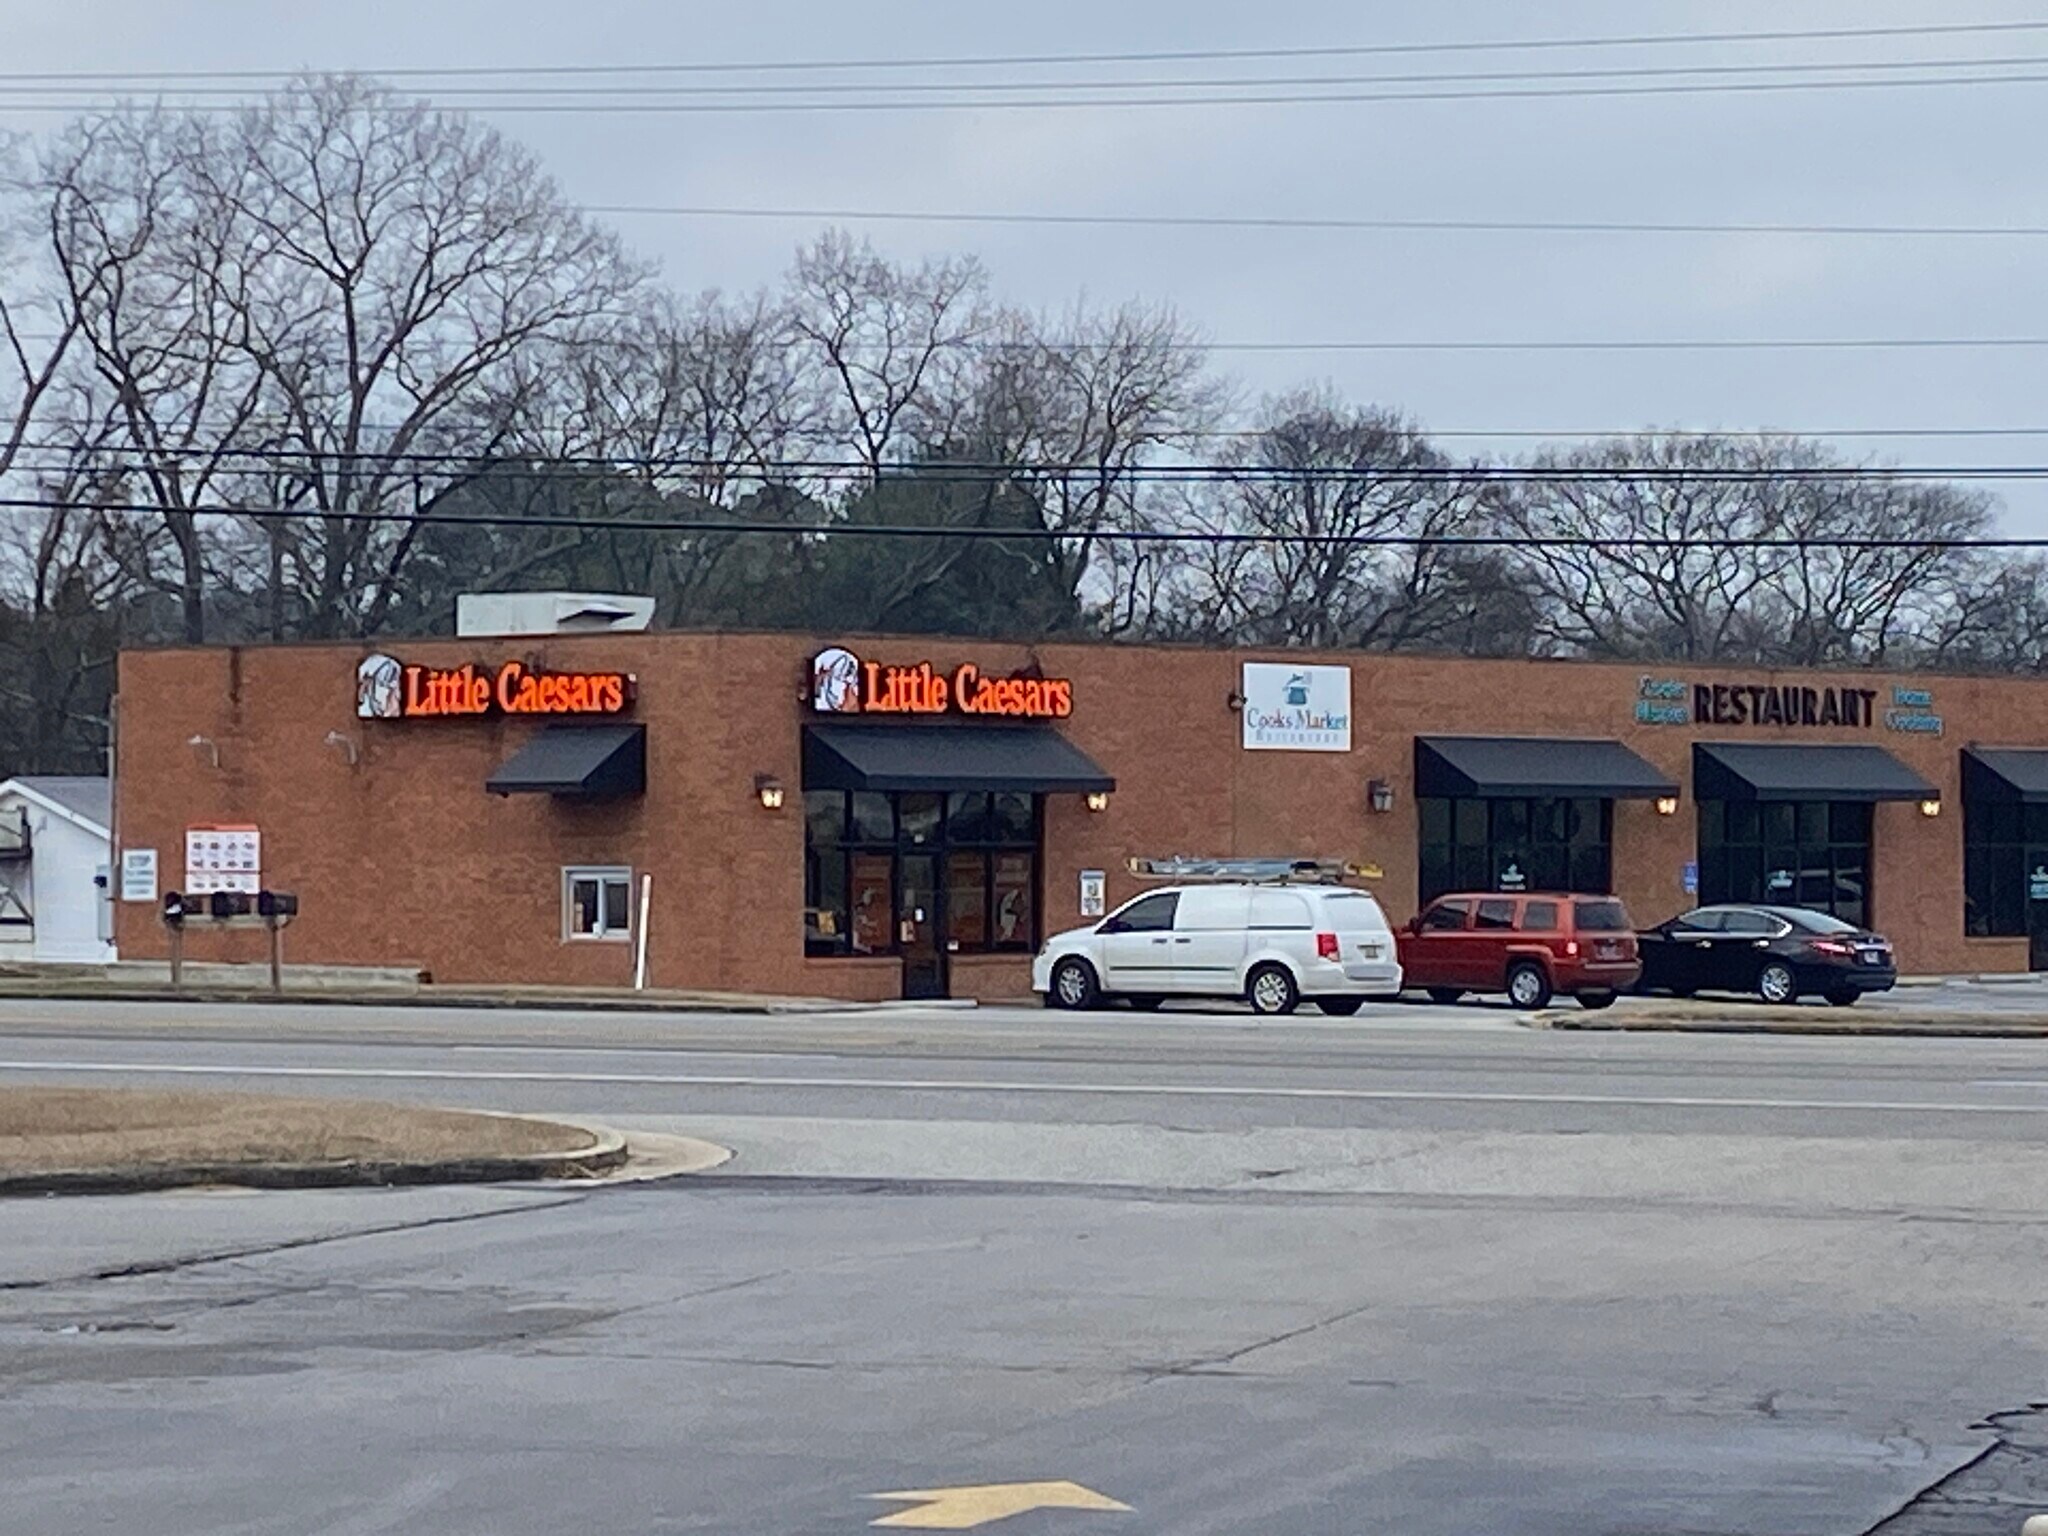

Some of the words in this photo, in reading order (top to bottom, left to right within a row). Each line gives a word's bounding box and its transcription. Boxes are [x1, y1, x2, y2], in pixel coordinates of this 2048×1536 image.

[405, 664, 490, 715] Little
[498, 661, 623, 712] Caesars
[864, 662, 948, 712] Little
[955, 663, 1070, 717] Caesars
[1693, 683, 1878, 727] RESTAURANT
[1247, 708, 1293, 729] Cooks
[1294, 709, 1348, 730] Market
